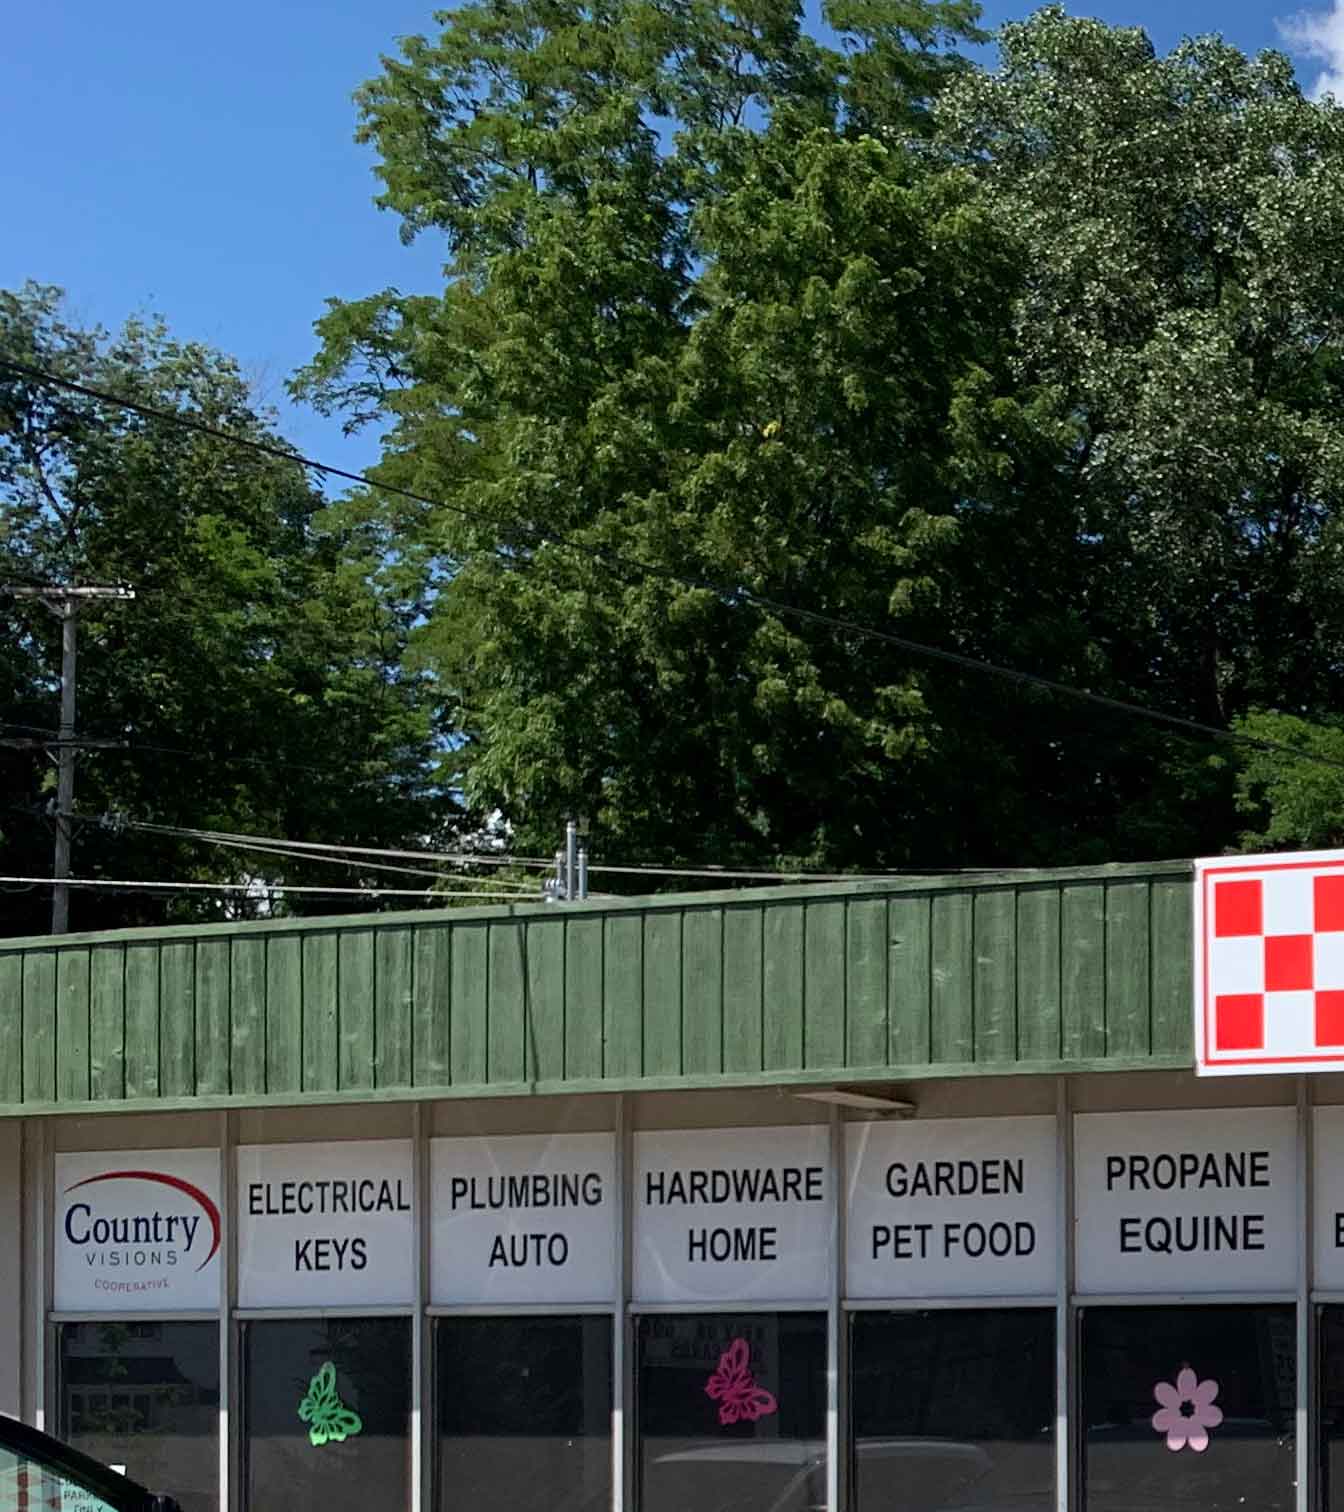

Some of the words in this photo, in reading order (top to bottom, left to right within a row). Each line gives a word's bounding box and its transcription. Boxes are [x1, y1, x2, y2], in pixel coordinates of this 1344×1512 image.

[646, 1167, 823, 1205] HARDWARE
[886, 1159, 1024, 1197] GARDEN
[1106, 1151, 1270, 1191] PROPANE
[249, 1179, 411, 1215] ELECTRICAL
[451, 1173, 602, 1210] PLUMBING
[64, 1203, 201, 1252] Country
[688, 1226, 777, 1262] HOME
[872, 1223, 933, 1259] PET
[943, 1221, 1036, 1258] FOOD
[1120, 1214, 1265, 1254] EQUINE
[85, 1250, 179, 1266] VISIONS
[295, 1238, 368, 1271] KEYS
[488, 1233, 569, 1268] AUTO
